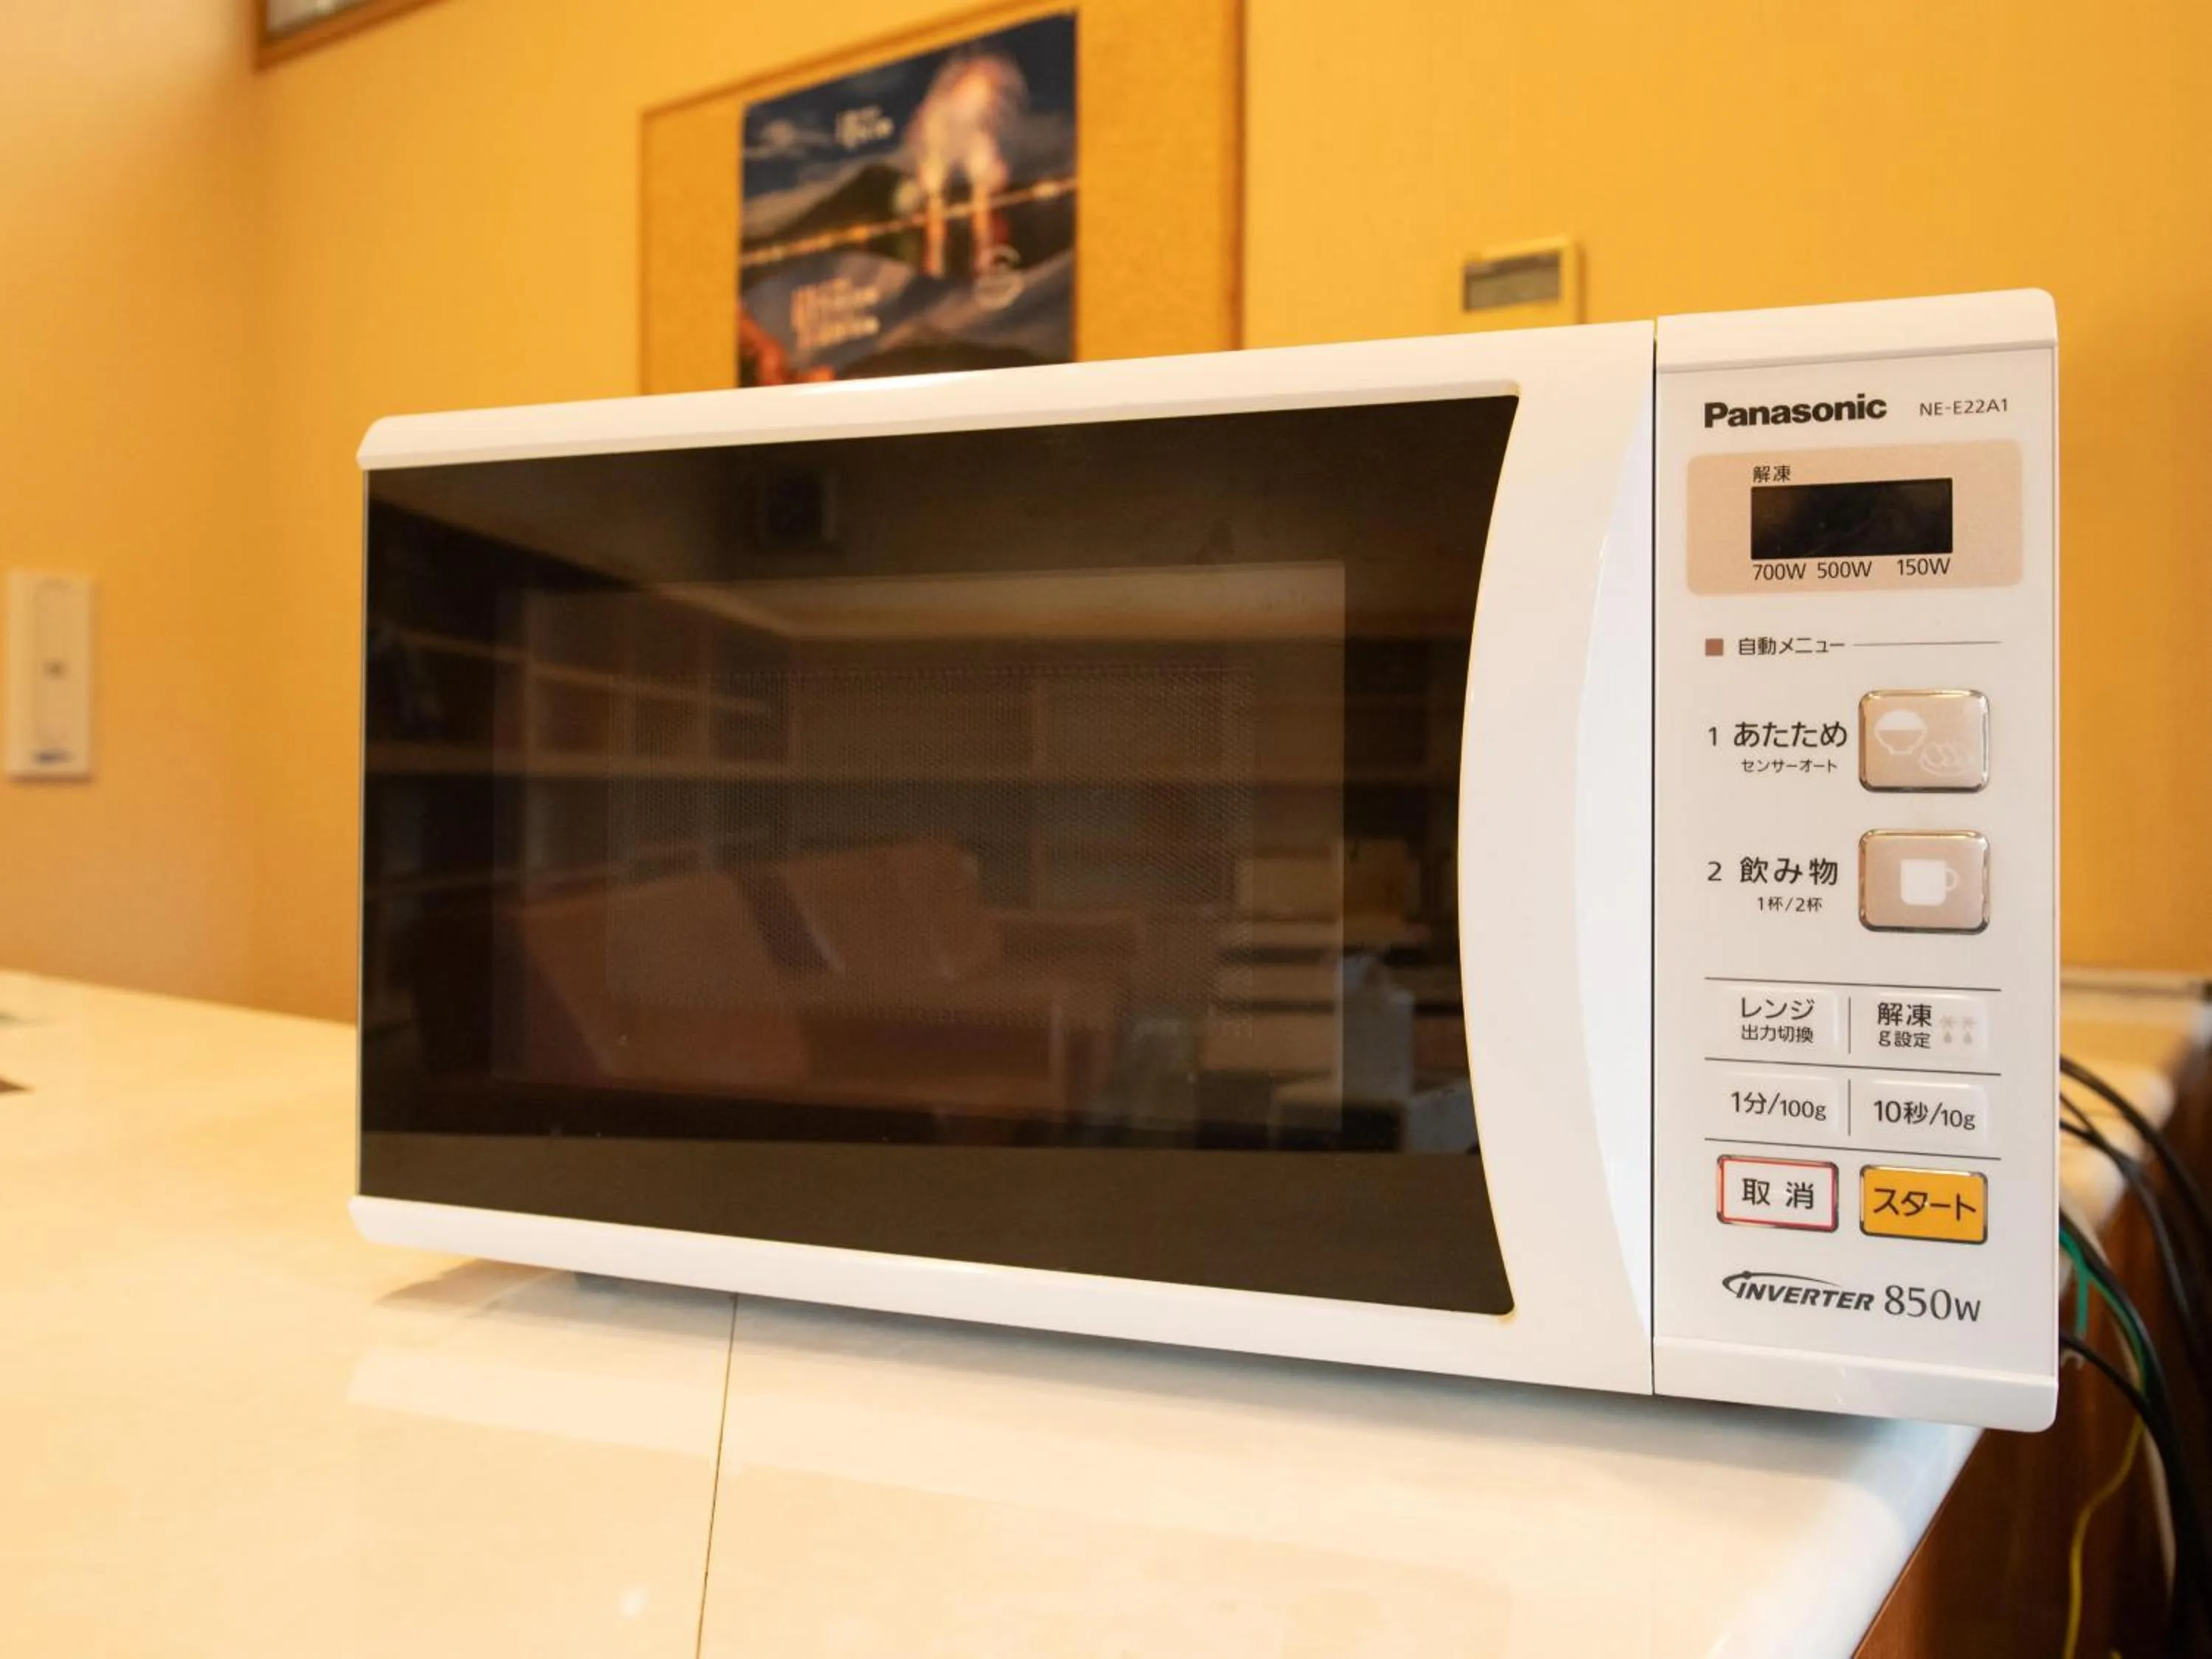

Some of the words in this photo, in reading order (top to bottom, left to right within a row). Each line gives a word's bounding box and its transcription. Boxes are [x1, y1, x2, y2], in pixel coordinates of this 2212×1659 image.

[1704, 393, 1888, 428] Panasonic
[1919, 397, 2008, 417] NE-E22A1
[1753, 465, 1791, 484] 解凍
[1753, 563, 1807, 581] 700W
[1817, 560, 1873, 579] 500W
[1897, 557, 1951, 576] 150W
[1738, 636, 1845, 655] 自動メニュー
[1708, 726, 1719, 747] 1
[1733, 720, 1848, 748] あたため
[1741, 758, 1837, 773] センサーオート
[1707, 860, 1722, 882] 2
[1739, 856, 1838, 886] 飲み物
[1741, 997, 1815, 1020] レンジ
[1877, 1002, 1933, 1028] 解凍
[1741, 1023, 1814, 1043] 出力切換
[1742, 1178, 1814, 1210] 取消
[1873, 1188, 1977, 1222] スタート
[1733, 1276, 1875, 1312] INVERTER
